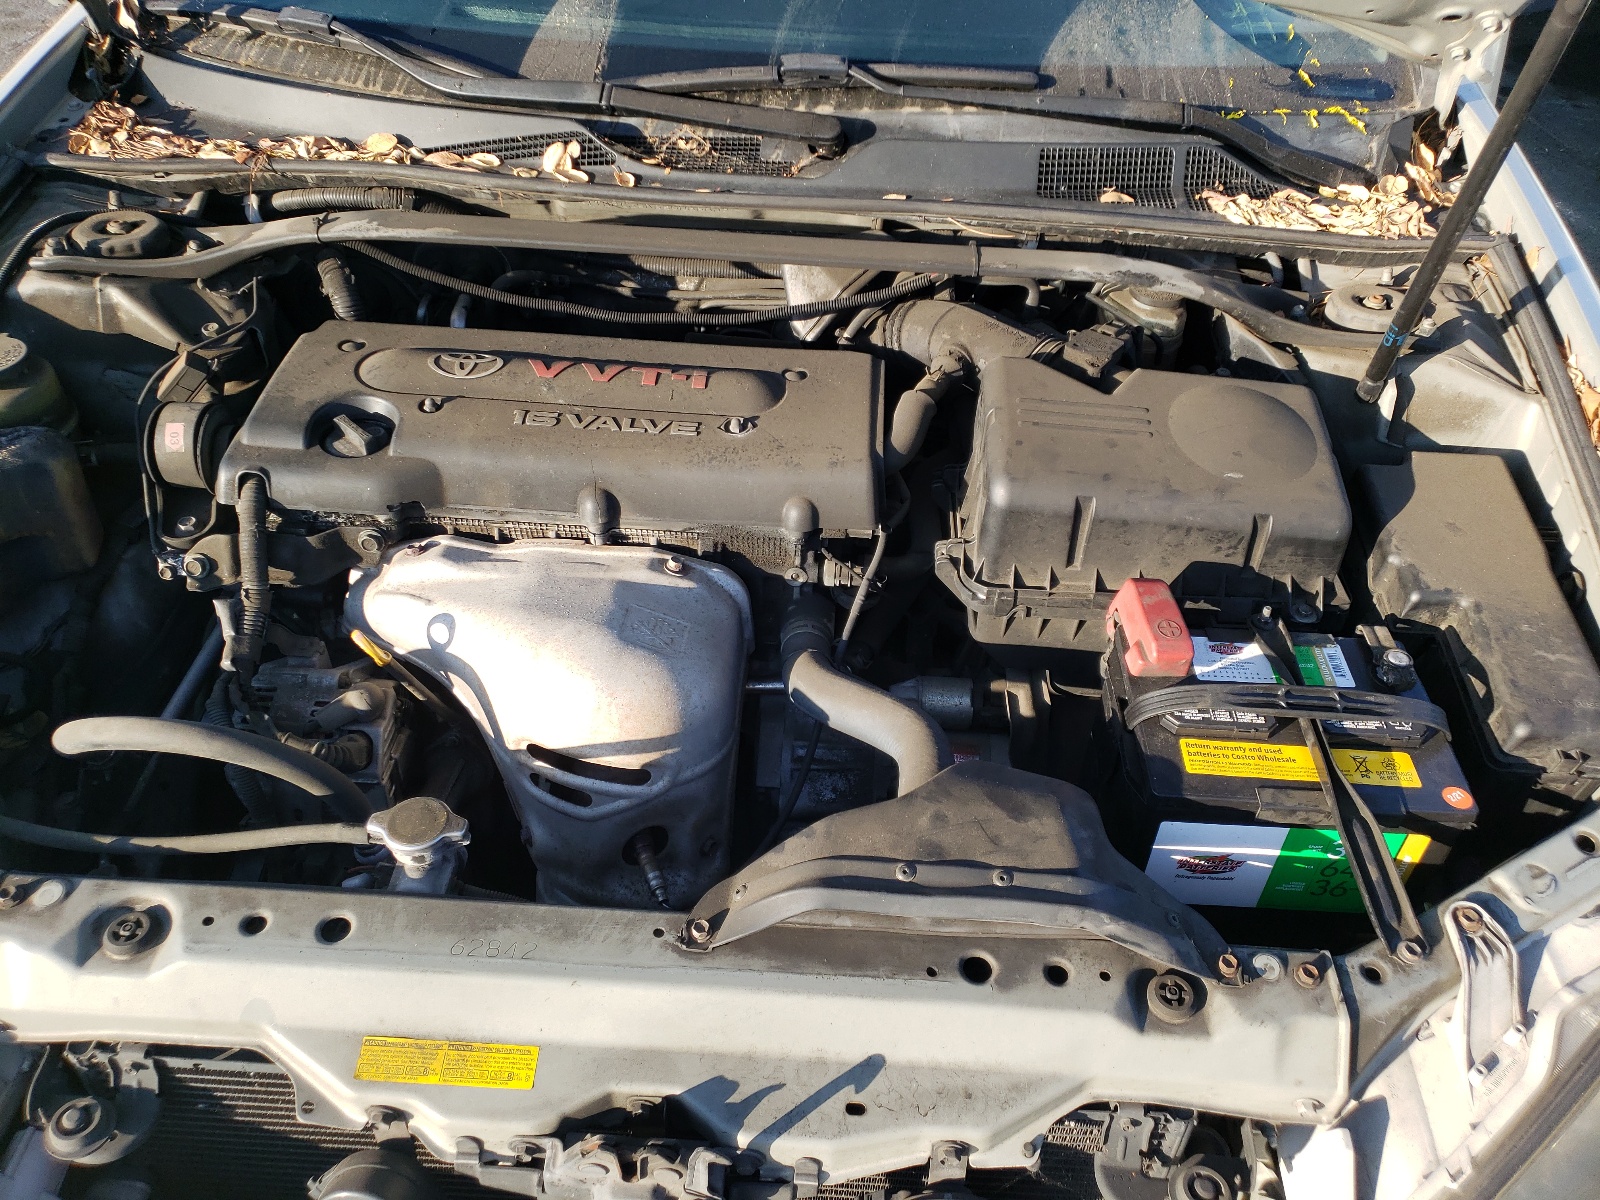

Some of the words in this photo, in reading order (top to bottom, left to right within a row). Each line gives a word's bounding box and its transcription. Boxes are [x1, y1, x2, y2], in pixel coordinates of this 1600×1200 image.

[513, 409, 562, 427] 16
[565, 412, 702, 437] VALVE
[1185, 741, 1212, 751] Return
[1212, 744, 1247, 754] warranty
[1248, 746, 1263, 754] and
[1264, 747, 1283, 755] used
[1187, 749, 1221, 760] batteries
[1222, 752, 1230, 760] to
[1231, 752, 1256, 761] Costco
[1257, 754, 1298, 764] Wholesale
[1446, 790, 1465, 802] 2/21
